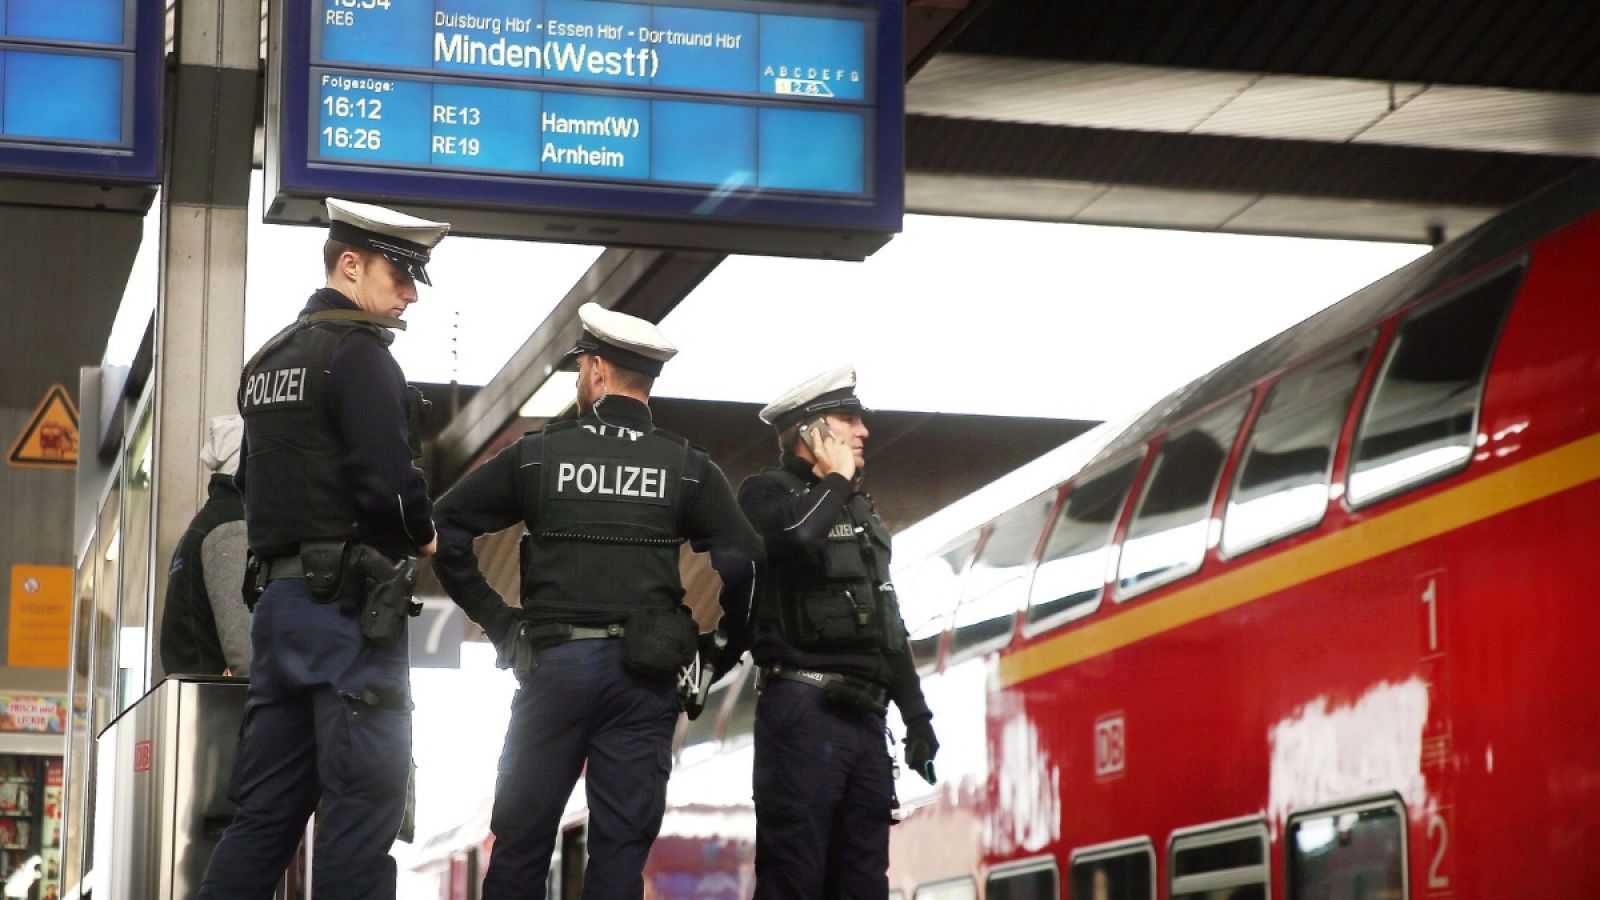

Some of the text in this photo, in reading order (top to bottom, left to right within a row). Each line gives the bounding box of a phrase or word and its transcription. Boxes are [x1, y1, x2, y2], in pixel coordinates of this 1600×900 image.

[326, 10, 354, 26] RE6
[435, 12, 501, 34] Duisburg
[505, 18, 530, 33] Hbf
[548, 20, 593, 38] Essen
[598, 24, 623, 40] Hbf
[639, 27, 712, 47] Dortmund
[716, 33, 742, 49] Hbf
[434, 32, 660, 78] Minden(Westf)
[764, 65, 775, 77] A
[823, 69, 831, 81] E
[836, 70, 845, 81] F
[322, 76, 394, 92] Folgezüge:
[323, 96, 640, 138] 16:12 RE13 Hamm(W)
[323, 126, 624, 167] 16:26 RE19 Arnheim
[243, 367, 307, 408] POLIZEI
[557, 463, 666, 498] POLIZEI
[411, 596, 456, 654] 7
[1422, 579, 1437, 650] 1
[136, 744, 149, 768] DB
[1099, 721, 1121, 772] DB
[1427, 815, 1449, 887] 2
